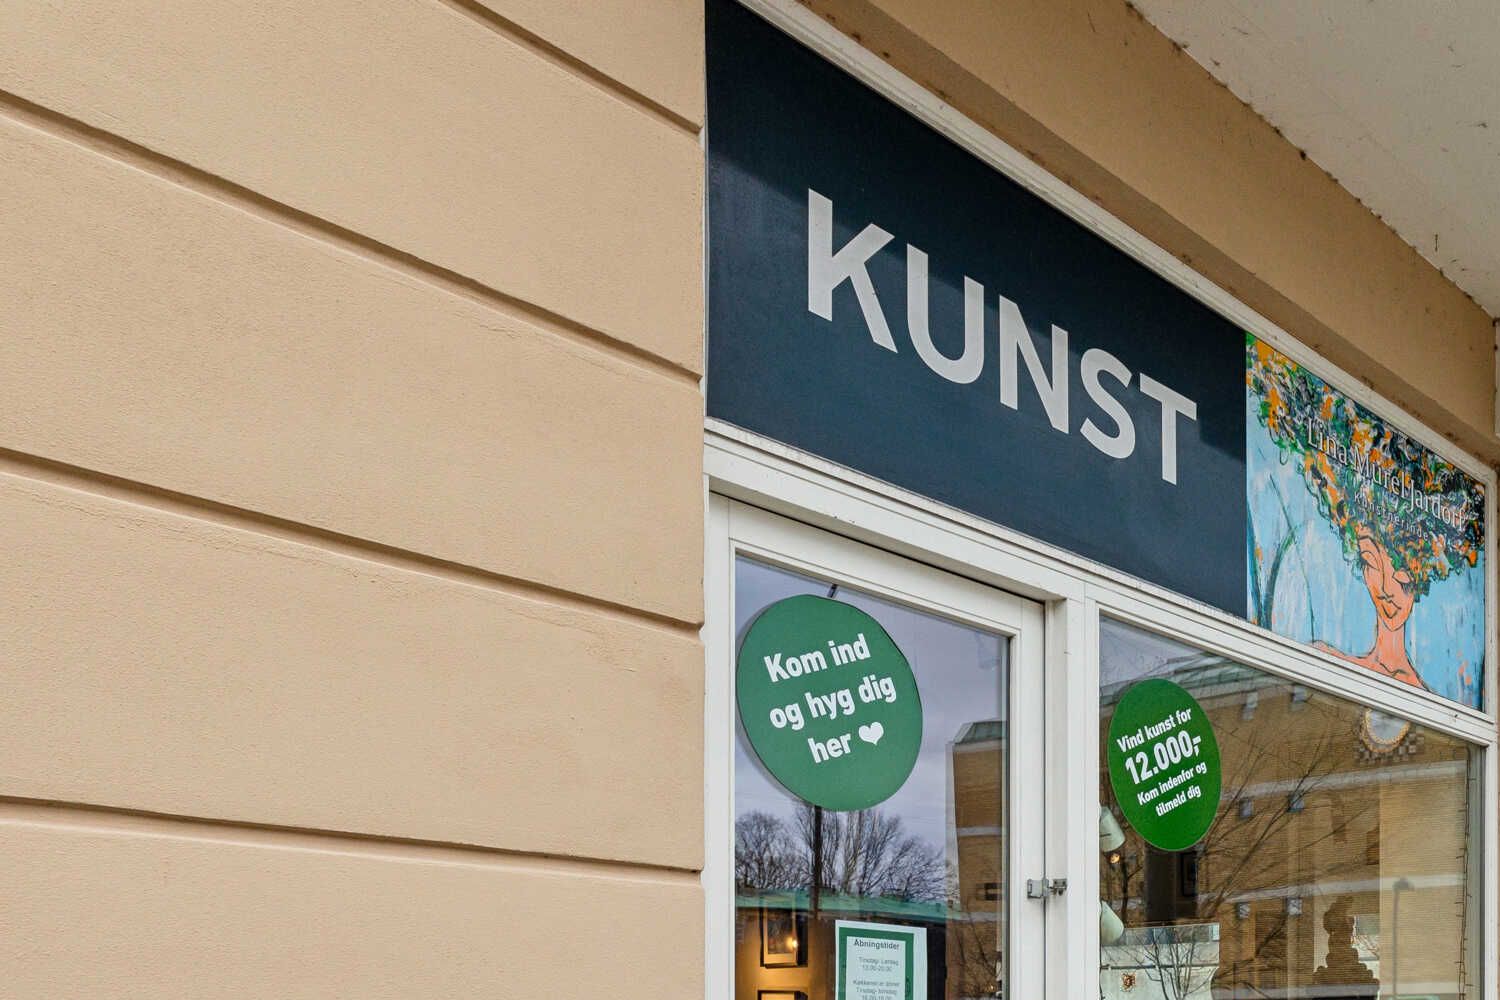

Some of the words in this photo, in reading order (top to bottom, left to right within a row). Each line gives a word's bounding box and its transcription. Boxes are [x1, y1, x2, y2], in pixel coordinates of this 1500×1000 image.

[808, 188, 1197, 486] KUNST
[1306, 416, 1348, 466] Lina
[1352, 446, 1406, 503] Murel
[763, 649, 828, 683] Kom
[828, 632, 871, 666] ind
[769, 702, 805, 731] og
[804, 688, 856, 720] hyg
[858, 674, 898, 704] dig
[807, 733, 851, 764] her
[1116, 729, 1145, 753] Vind
[1144, 715, 1177, 741] kunst
[1176, 708, 1193, 725] for
[1137, 787, 1159, 806] Kom
[1158, 766, 1195, 794] indenfor
[1196, 761, 1208, 775] og
[1156, 794, 1187, 817] tilmeld
[1187, 785, 1202, 799] dig
